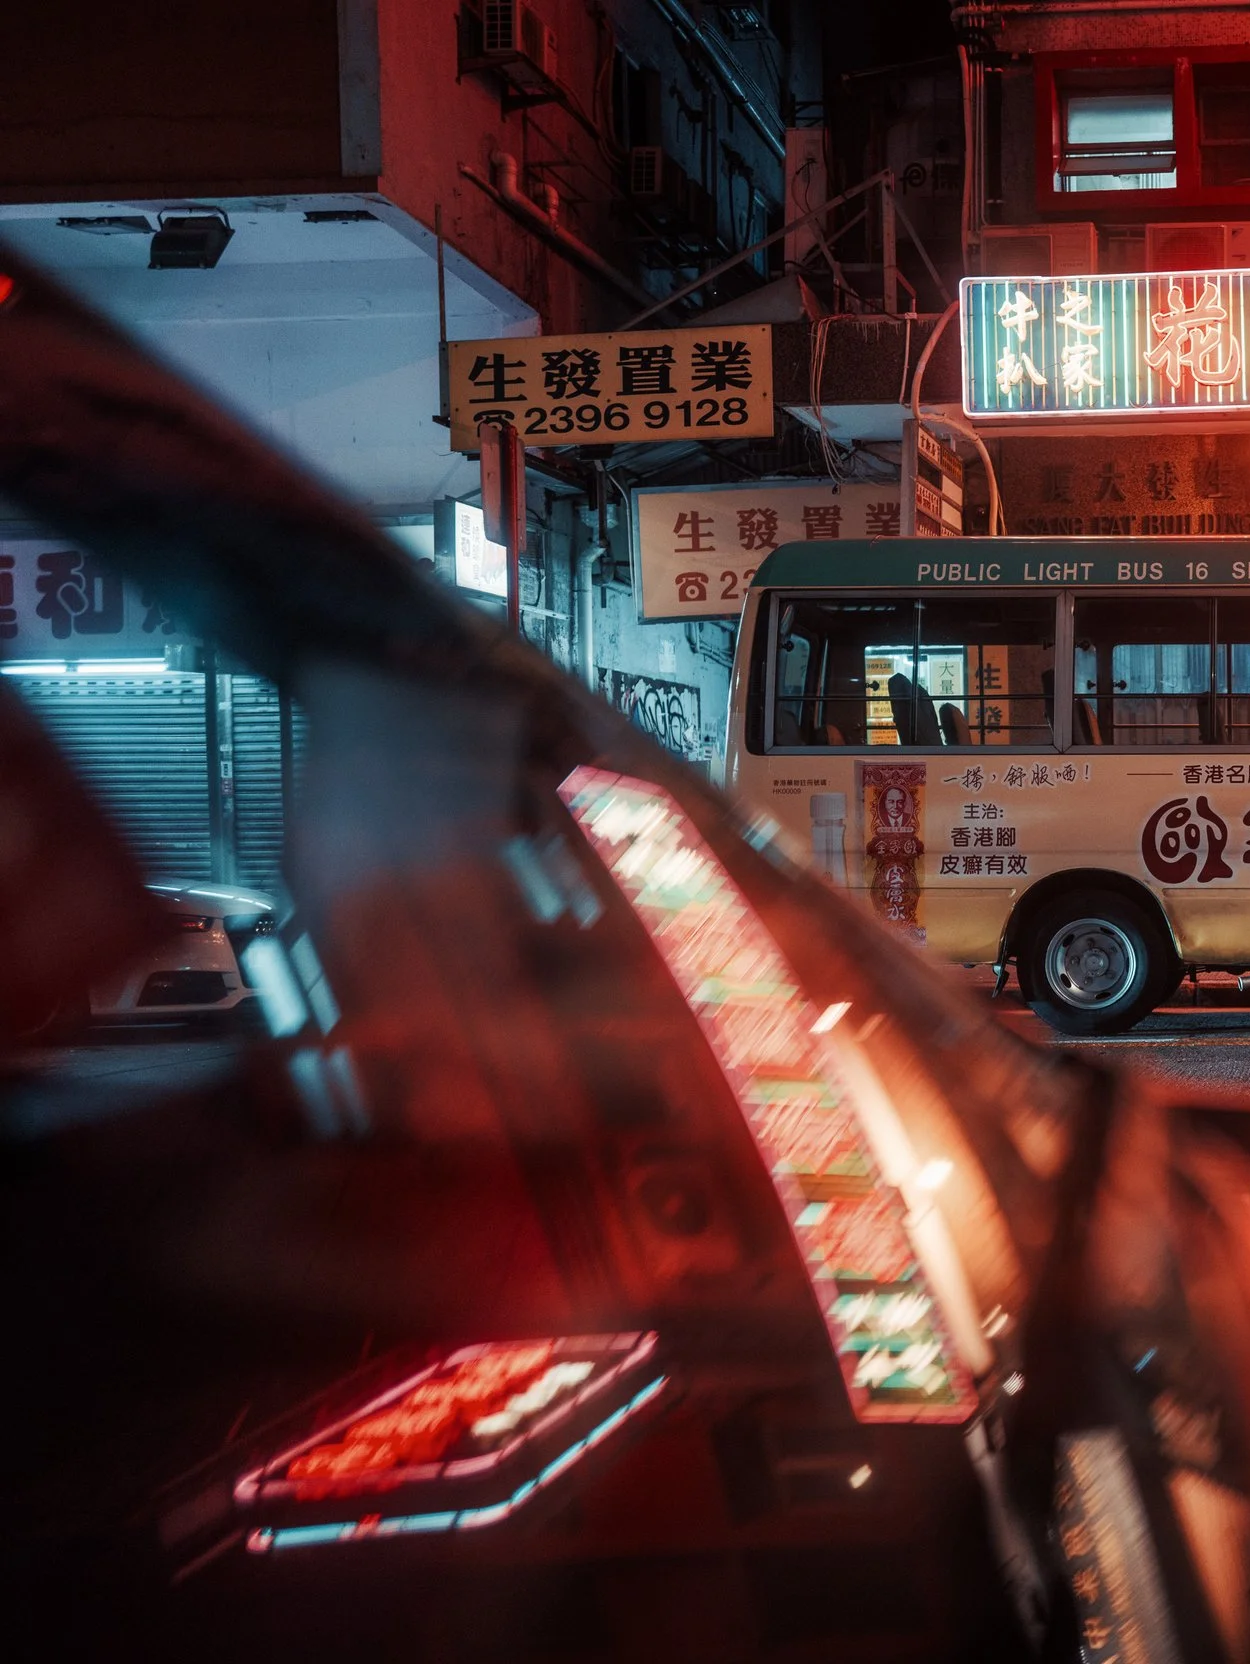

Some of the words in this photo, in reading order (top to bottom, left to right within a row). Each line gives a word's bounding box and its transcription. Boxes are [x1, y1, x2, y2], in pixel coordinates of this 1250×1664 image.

[468, 341, 753, 404] 生發置業
[524, 402, 630, 435] 2396
[644, 397, 749, 428] 9128
[673, 502, 900, 553] 生發置業
[917, 563, 1001, 582] PUBLIC
[1024, 563, 1094, 581] LIGHT
[1117, 562, 1164, 580] BUS
[1186, 562, 1209, 580] 16
[950, 827, 1016, 848] 香港腳
[939, 855, 1028, 875] 皮癬有效
